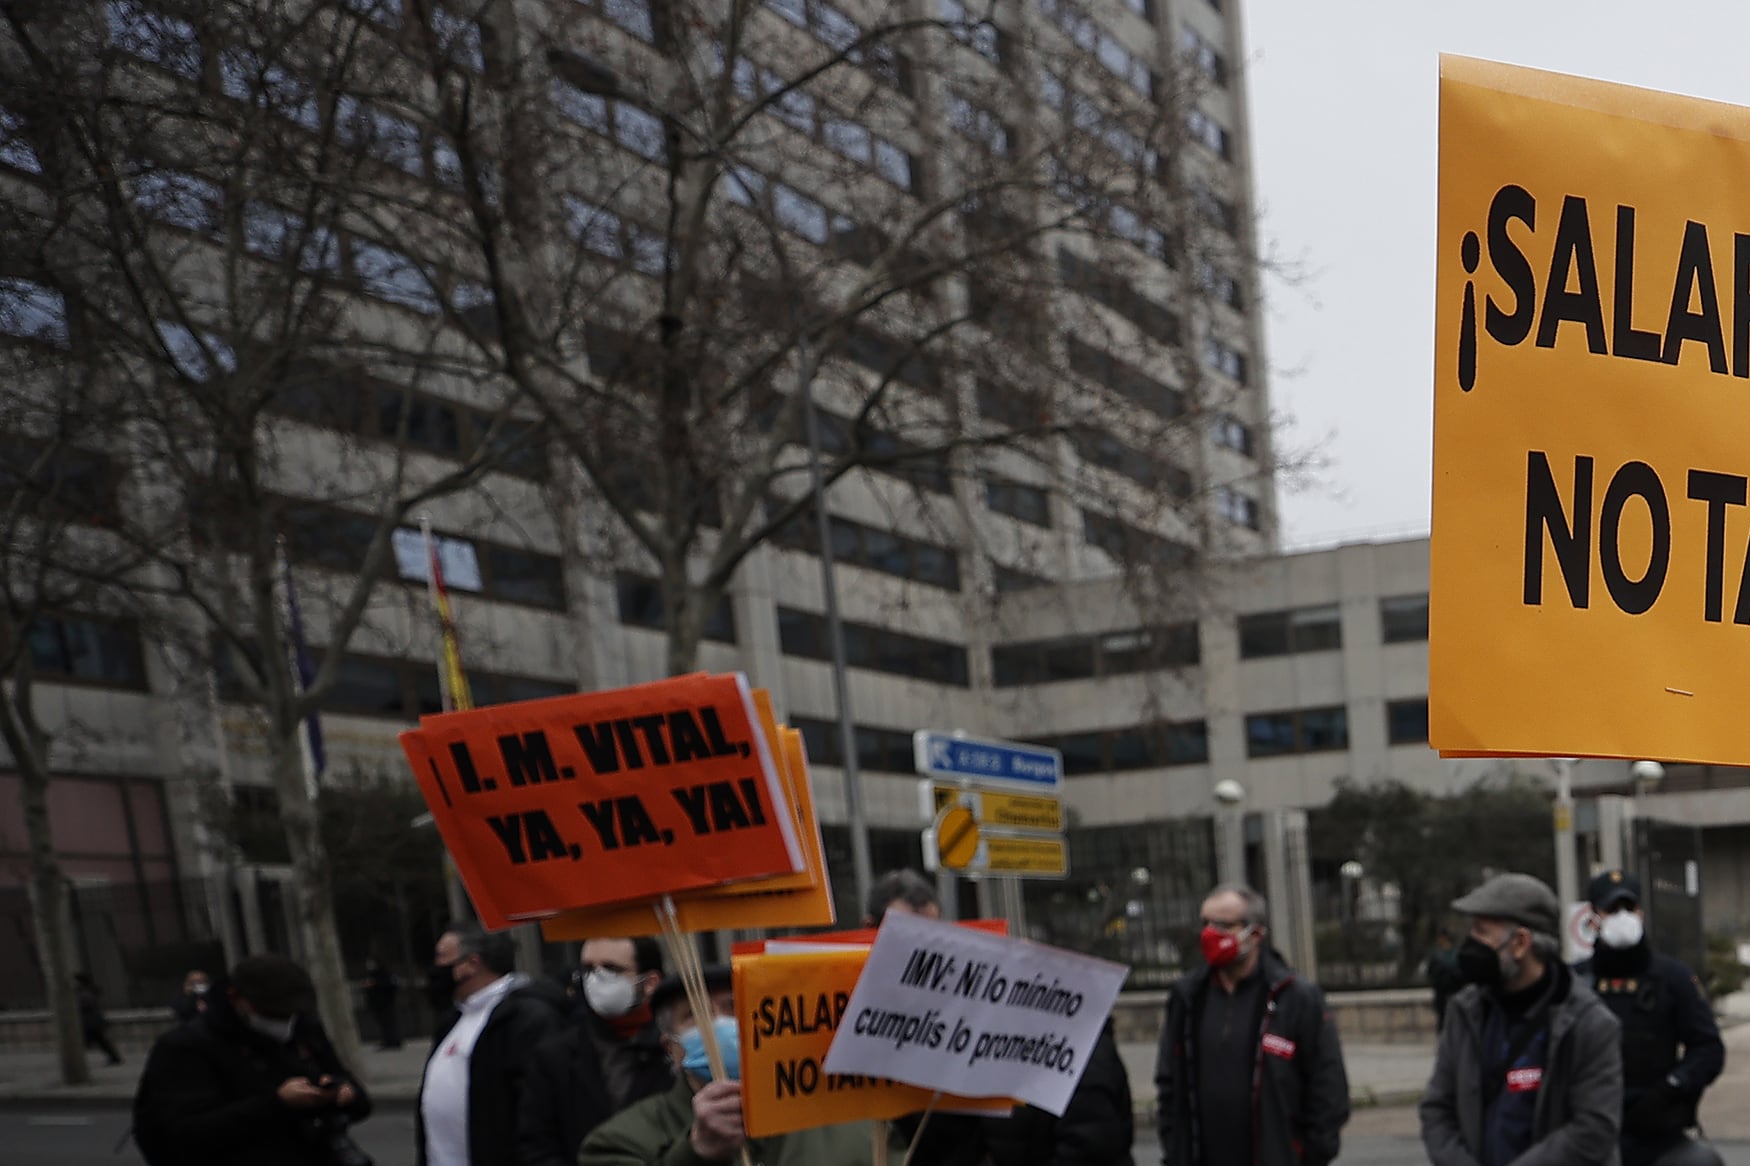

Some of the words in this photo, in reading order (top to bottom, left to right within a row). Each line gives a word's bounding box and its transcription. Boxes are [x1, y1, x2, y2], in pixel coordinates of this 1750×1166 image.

[1523, 450, 1671, 615] NO
[450, 741, 496, 794] I.
[497, 731, 576, 786] M.
[573, 706, 750, 775] VITAL,
[487, 810, 581, 865] YA,
[579, 795, 674, 851] YA,
[671, 778, 765, 835] YA!
[900, 948, 955, 993] IMV:
[954, 960, 987, 1000] Ni
[982, 964, 1006, 1004] lo
[775, 1058, 818, 1100] NO
[854, 1007, 946, 1050] cumplís
[946, 1017, 971, 1055] lo
[968, 1028, 1075, 1077] prometido.
